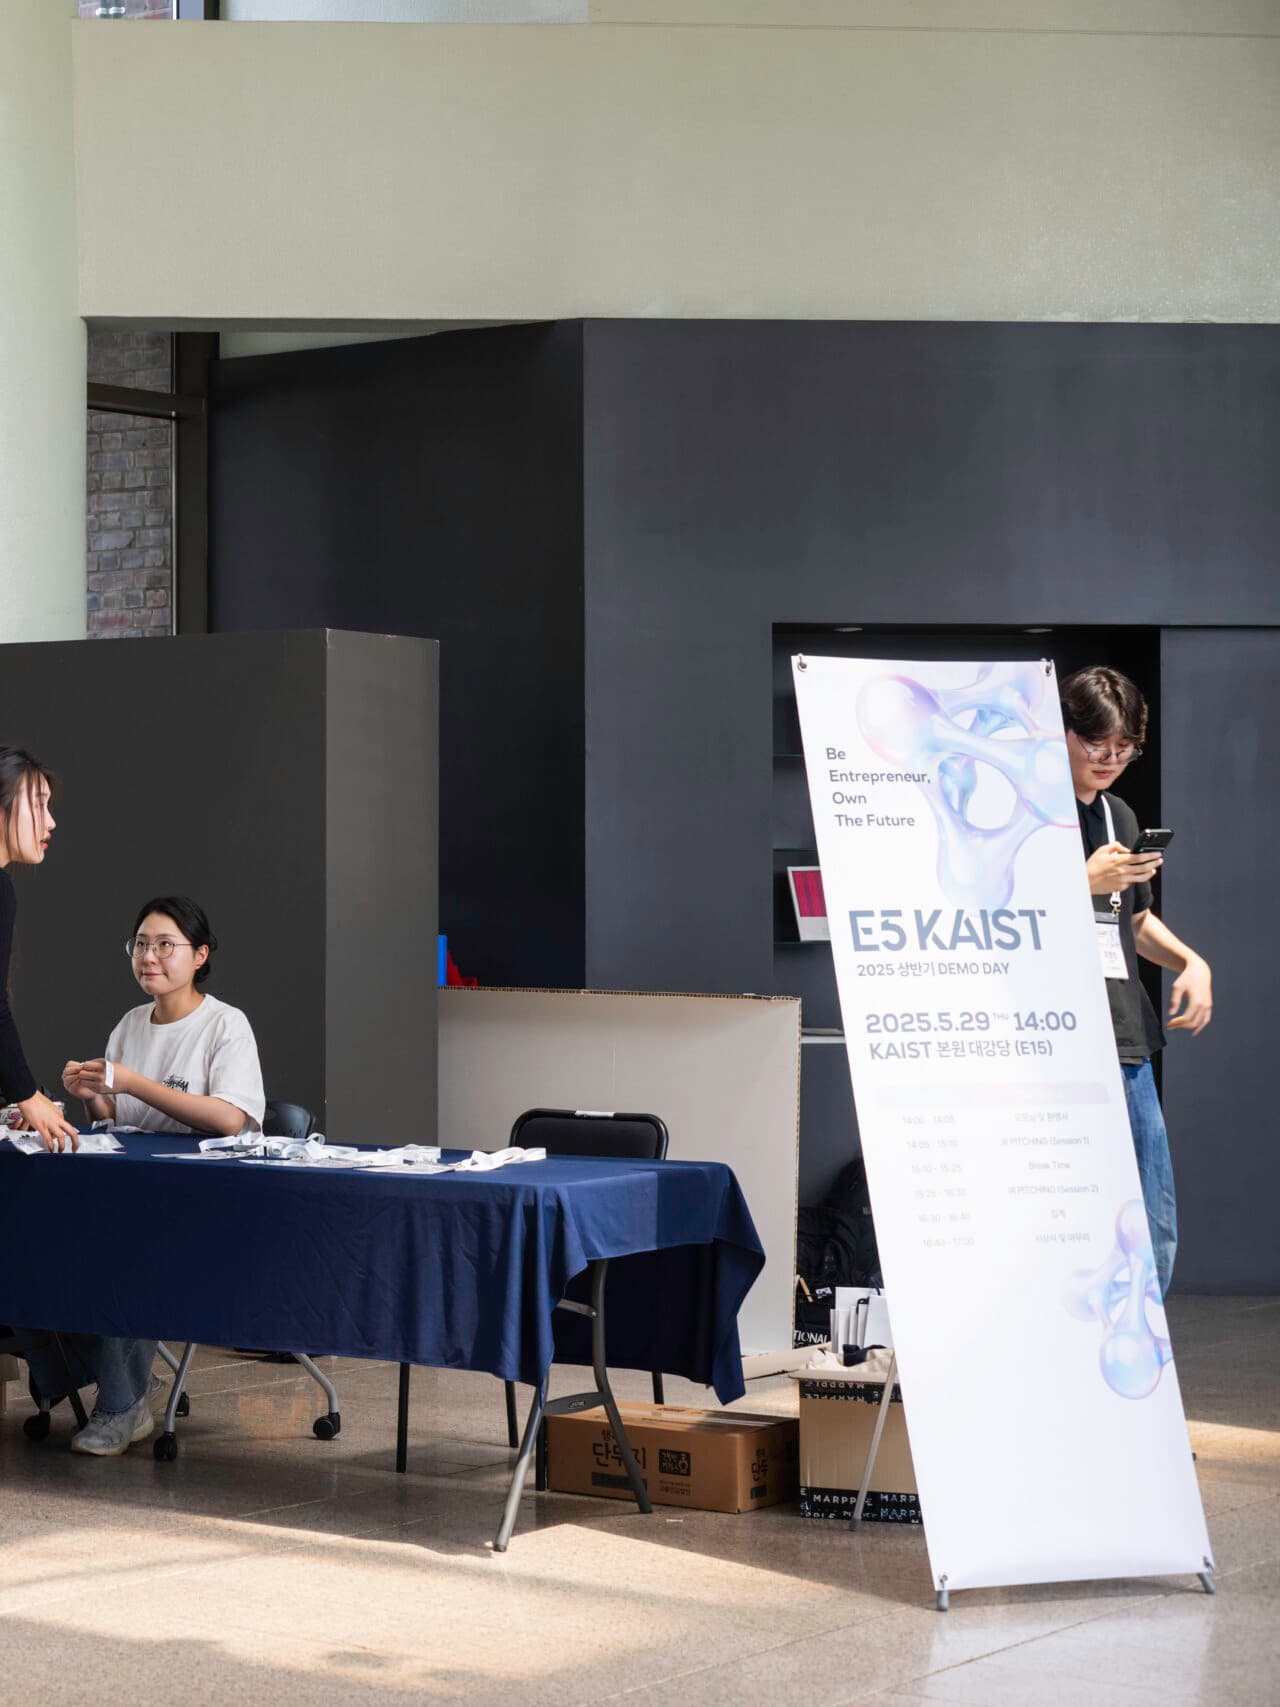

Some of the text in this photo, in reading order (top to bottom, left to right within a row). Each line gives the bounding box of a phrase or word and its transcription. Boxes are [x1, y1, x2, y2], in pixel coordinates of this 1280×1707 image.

[826, 747, 846, 760] Be
[829, 769, 931, 785] Entrepreneur,
[832, 792, 867, 804] Own
[834, 814, 915, 827] The Future
[848, 908, 1047, 952] E5 KAIST
[857, 962, 1010, 977] 2025 상반기 DEMO DAY
[866, 1011, 991, 1034] 2025.5.29
[1013, 1010, 1077, 1031] 14:00
[869, 1039, 1053, 1060] KAIST 본원 대강당 (E15)
[813, 1493, 873, 1507] MARPPE
